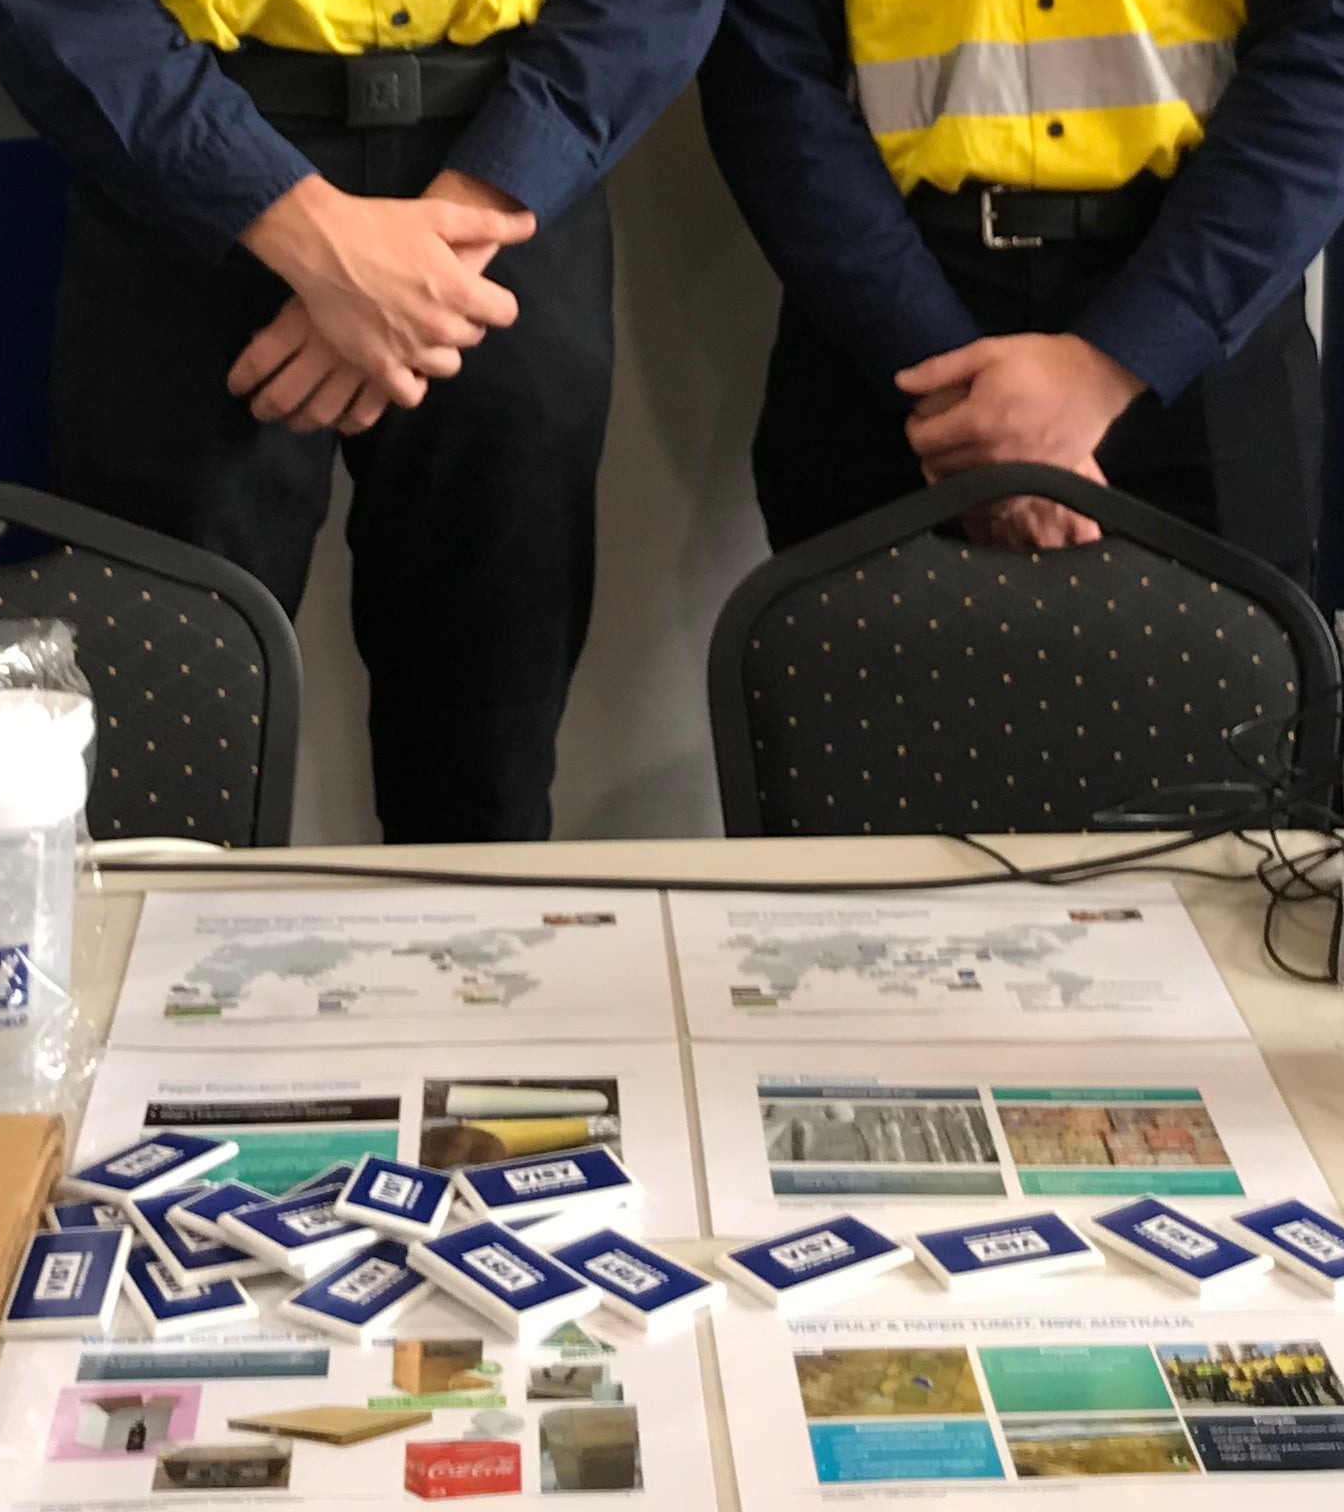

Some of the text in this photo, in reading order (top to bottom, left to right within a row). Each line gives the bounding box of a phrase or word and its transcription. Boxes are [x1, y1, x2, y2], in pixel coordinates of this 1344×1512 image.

[513, 1165, 570, 1185] VISY
[782, 1235, 837, 1261] VISY
[903, 1317, 966, 1333] PAPER
